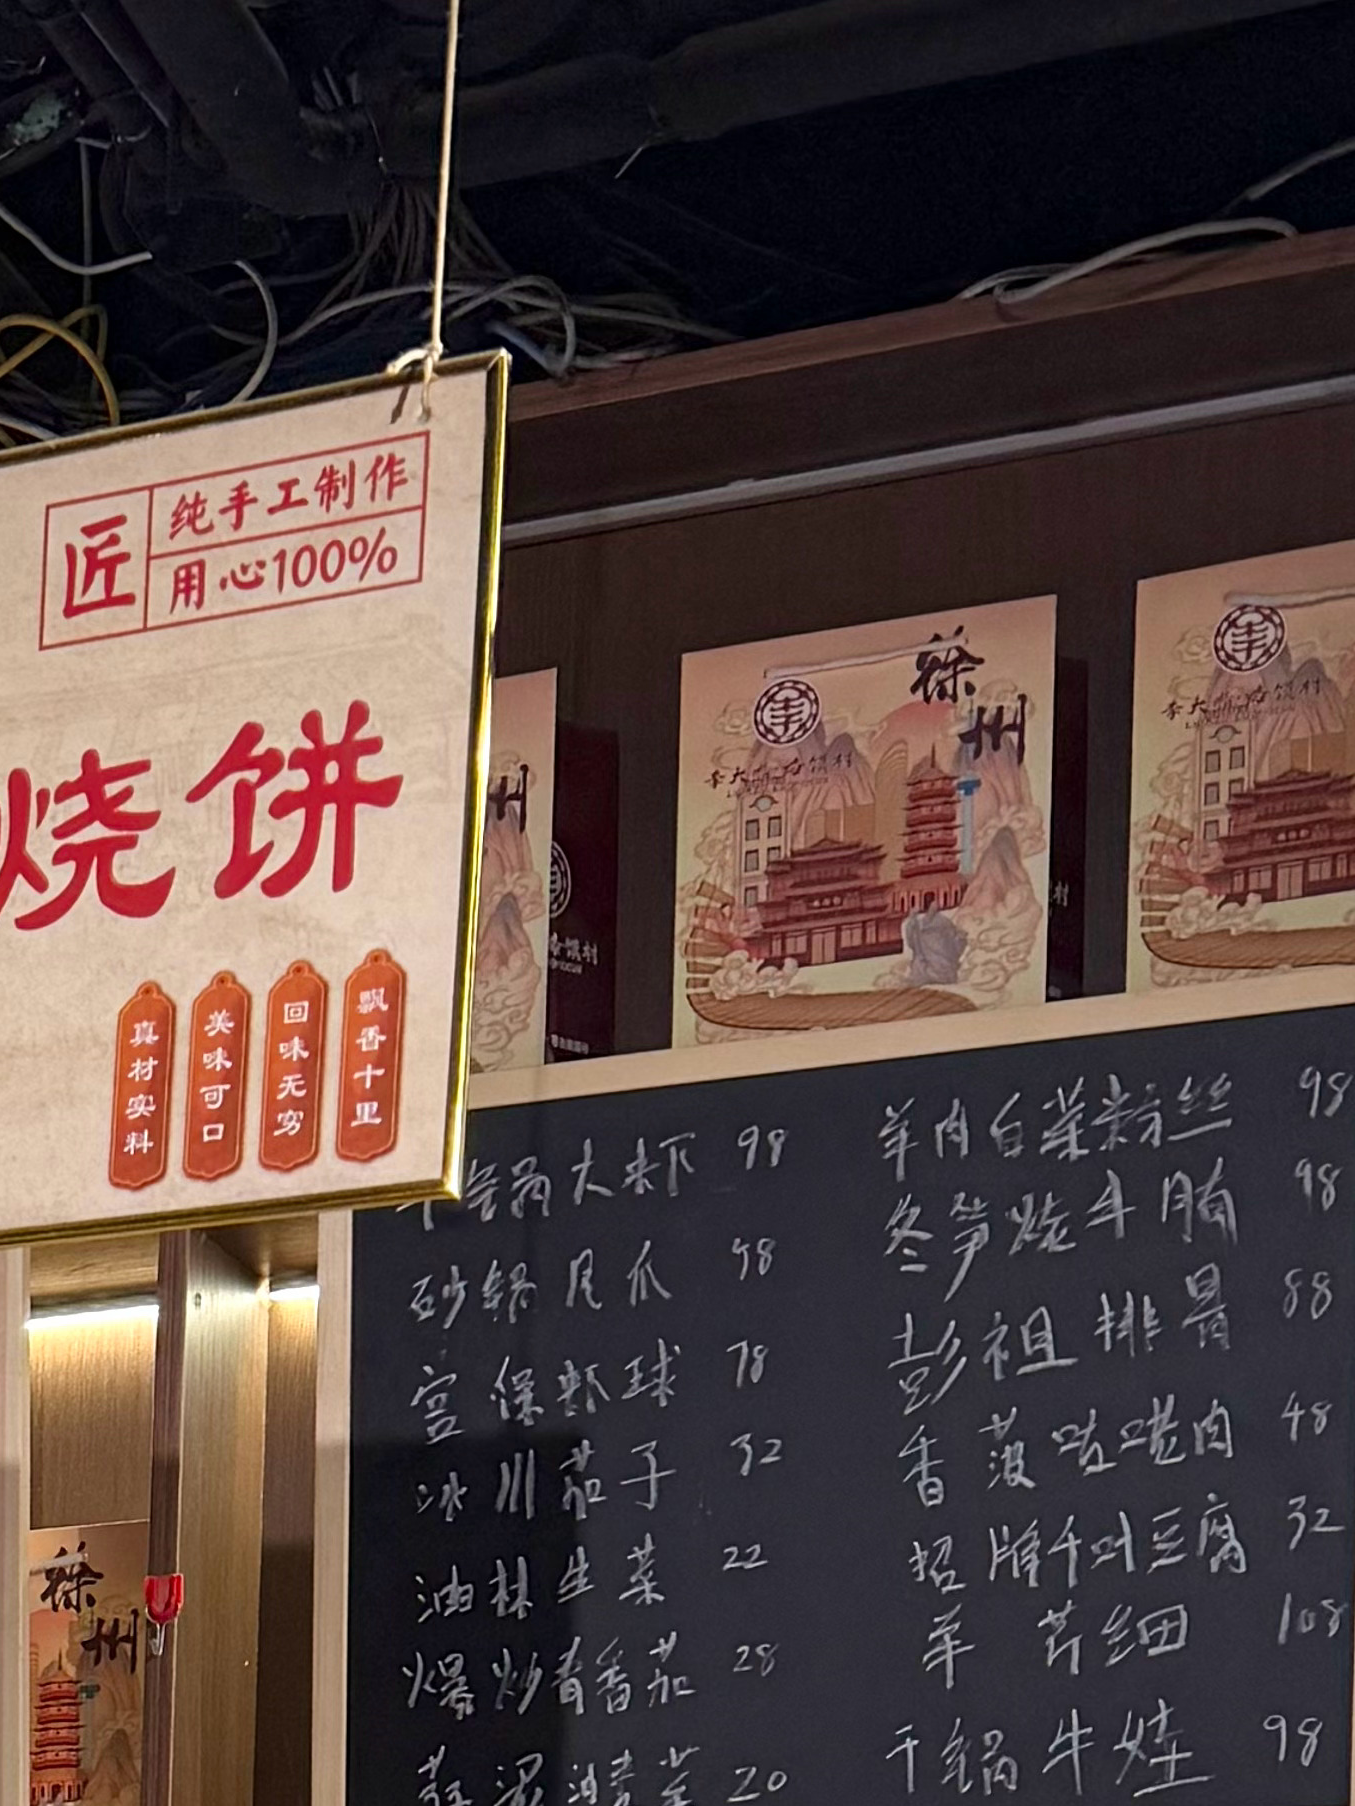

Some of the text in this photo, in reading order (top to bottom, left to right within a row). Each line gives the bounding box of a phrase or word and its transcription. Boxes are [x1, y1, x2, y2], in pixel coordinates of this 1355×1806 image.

[169, 452, 409, 541] 纯手工制作
[62, 513, 136, 620] 匠
[169, 525, 399, 615] 用心100%
[122, 1019, 160, 1156] 真材实料
[198, 1007, 235, 1143] 美味可口
[272, 999, 310, 1137] 回味无穷
[349, 986, 390, 1128] 飘香十里
[1299, 1065, 1354, 1119] 98
[722, 1542, 770, 1573] 22
[732, 1641, 782, 1678] 28
[1262, 1713, 1324, 1769] 98
